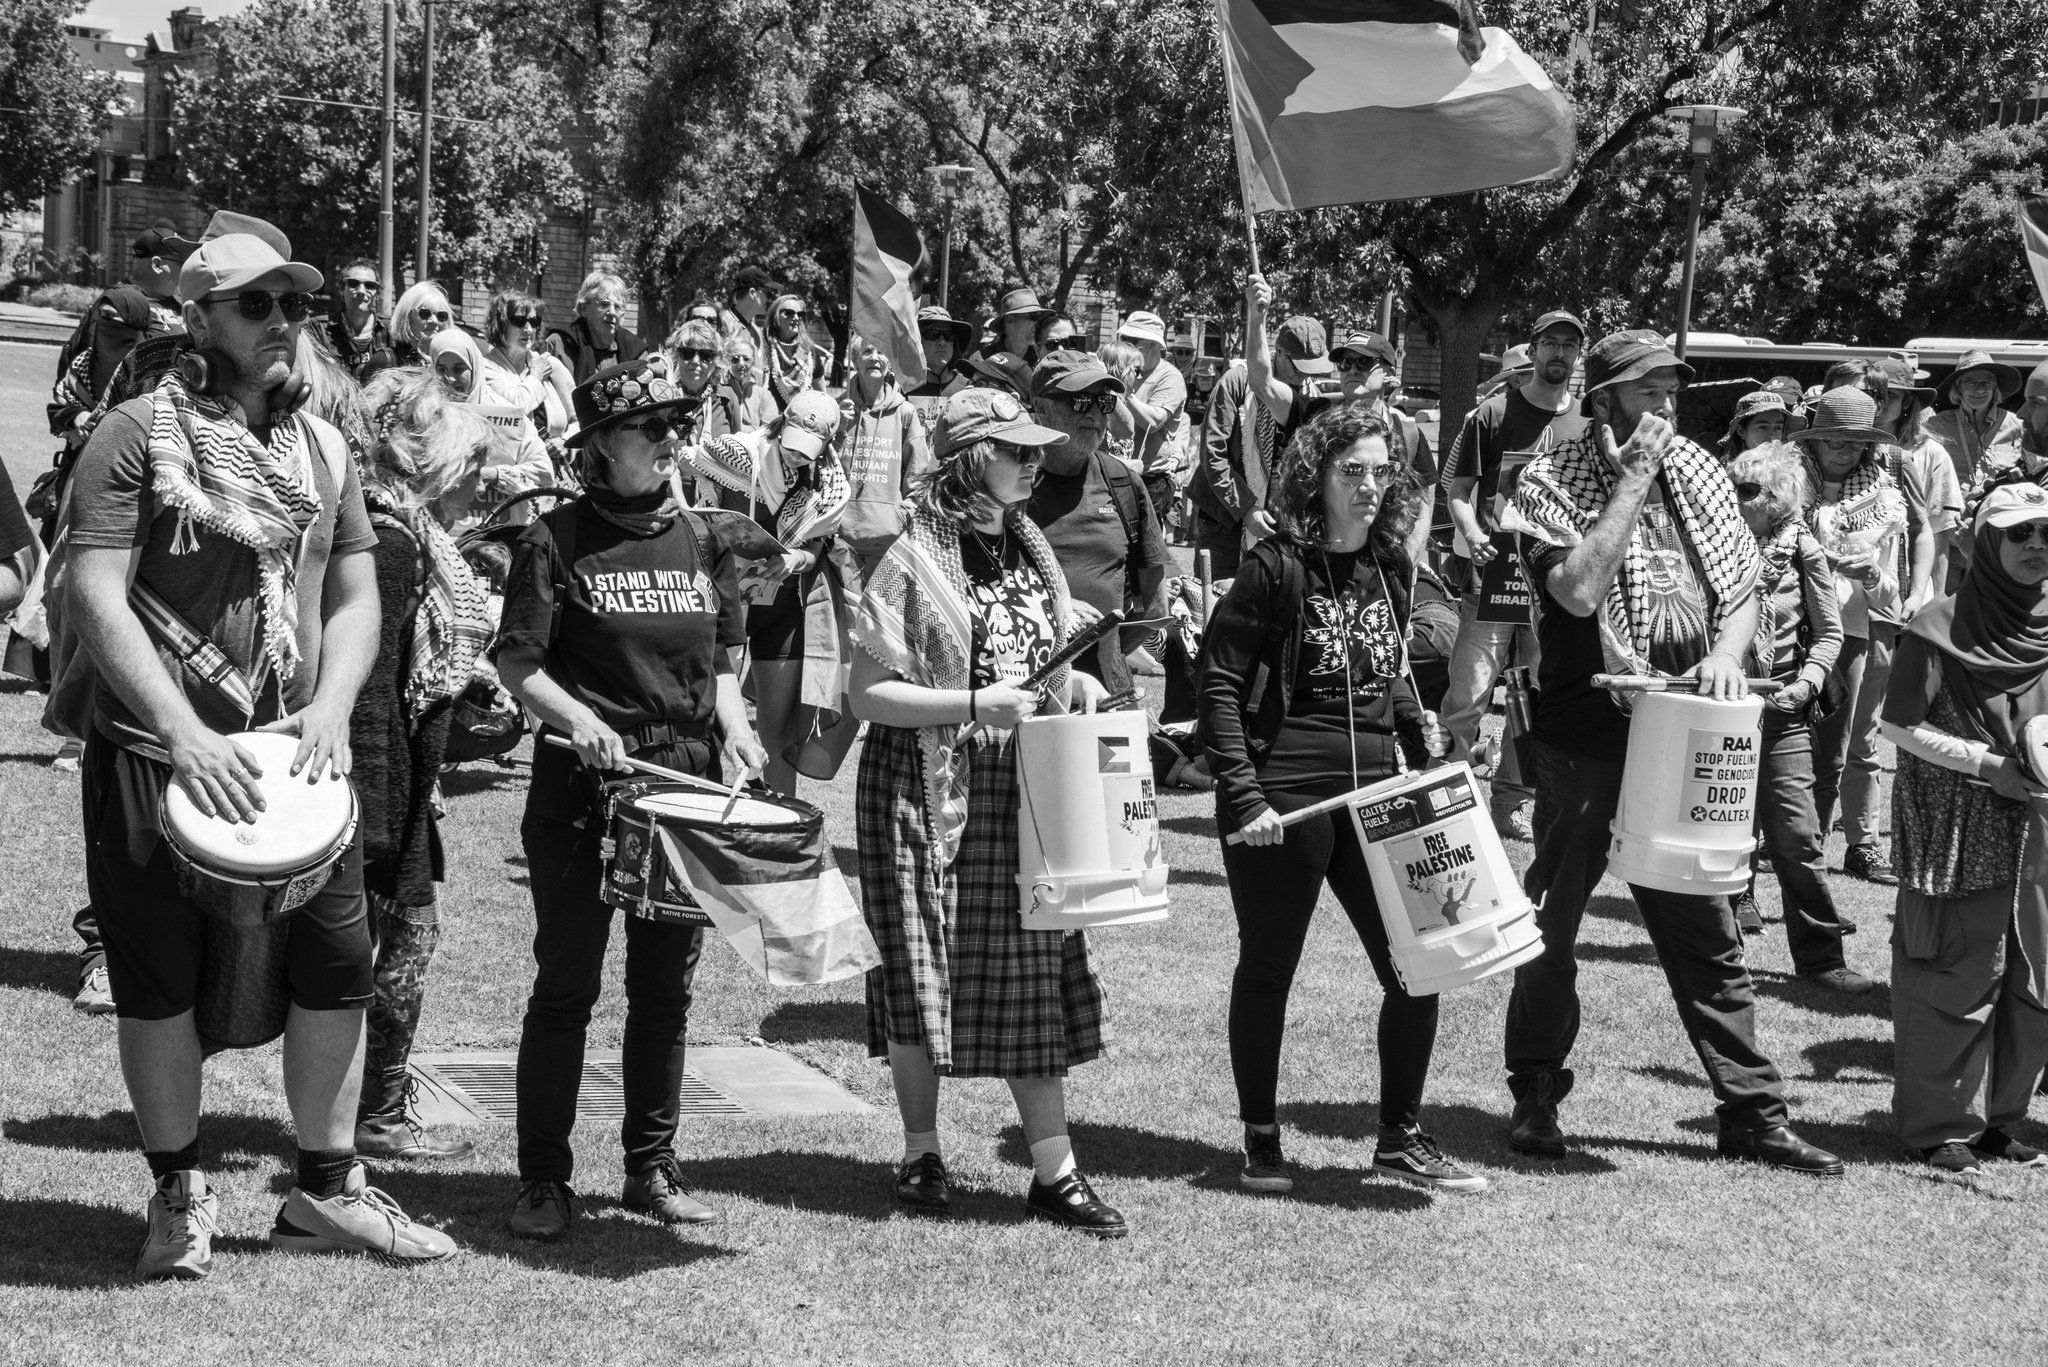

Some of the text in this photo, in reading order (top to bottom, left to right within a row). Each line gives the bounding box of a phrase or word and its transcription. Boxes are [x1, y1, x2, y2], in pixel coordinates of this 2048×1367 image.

[484, 415, 520, 427] STINE
[851, 460, 889, 471] HUMAN
[849, 471, 888, 484] RIGHTS
[1508, 553, 1520, 563] P
[584, 569, 692, 592] I STAND WITH
[1504, 581, 1529, 592] TOR
[590, 590, 704, 613] PALESTINE
[1722, 736, 1752, 751] RAA
[1694, 752, 1724, 765] STOP
[1717, 768, 1756, 781] GENOCIDE
[1706, 786, 1747, 804] DROP
[1360, 801, 1394, 818] CALTEX
[1708, 809, 1750, 822] CALTEX
[1363, 814, 1390, 829] FUELS
[1368, 818, 1413, 839] GENOCIDE
[1423, 831, 1450, 856] FREE
[1405, 844, 1476, 881] PALESTINE
[661, 909, 708, 920] NATIVE FORESTS
